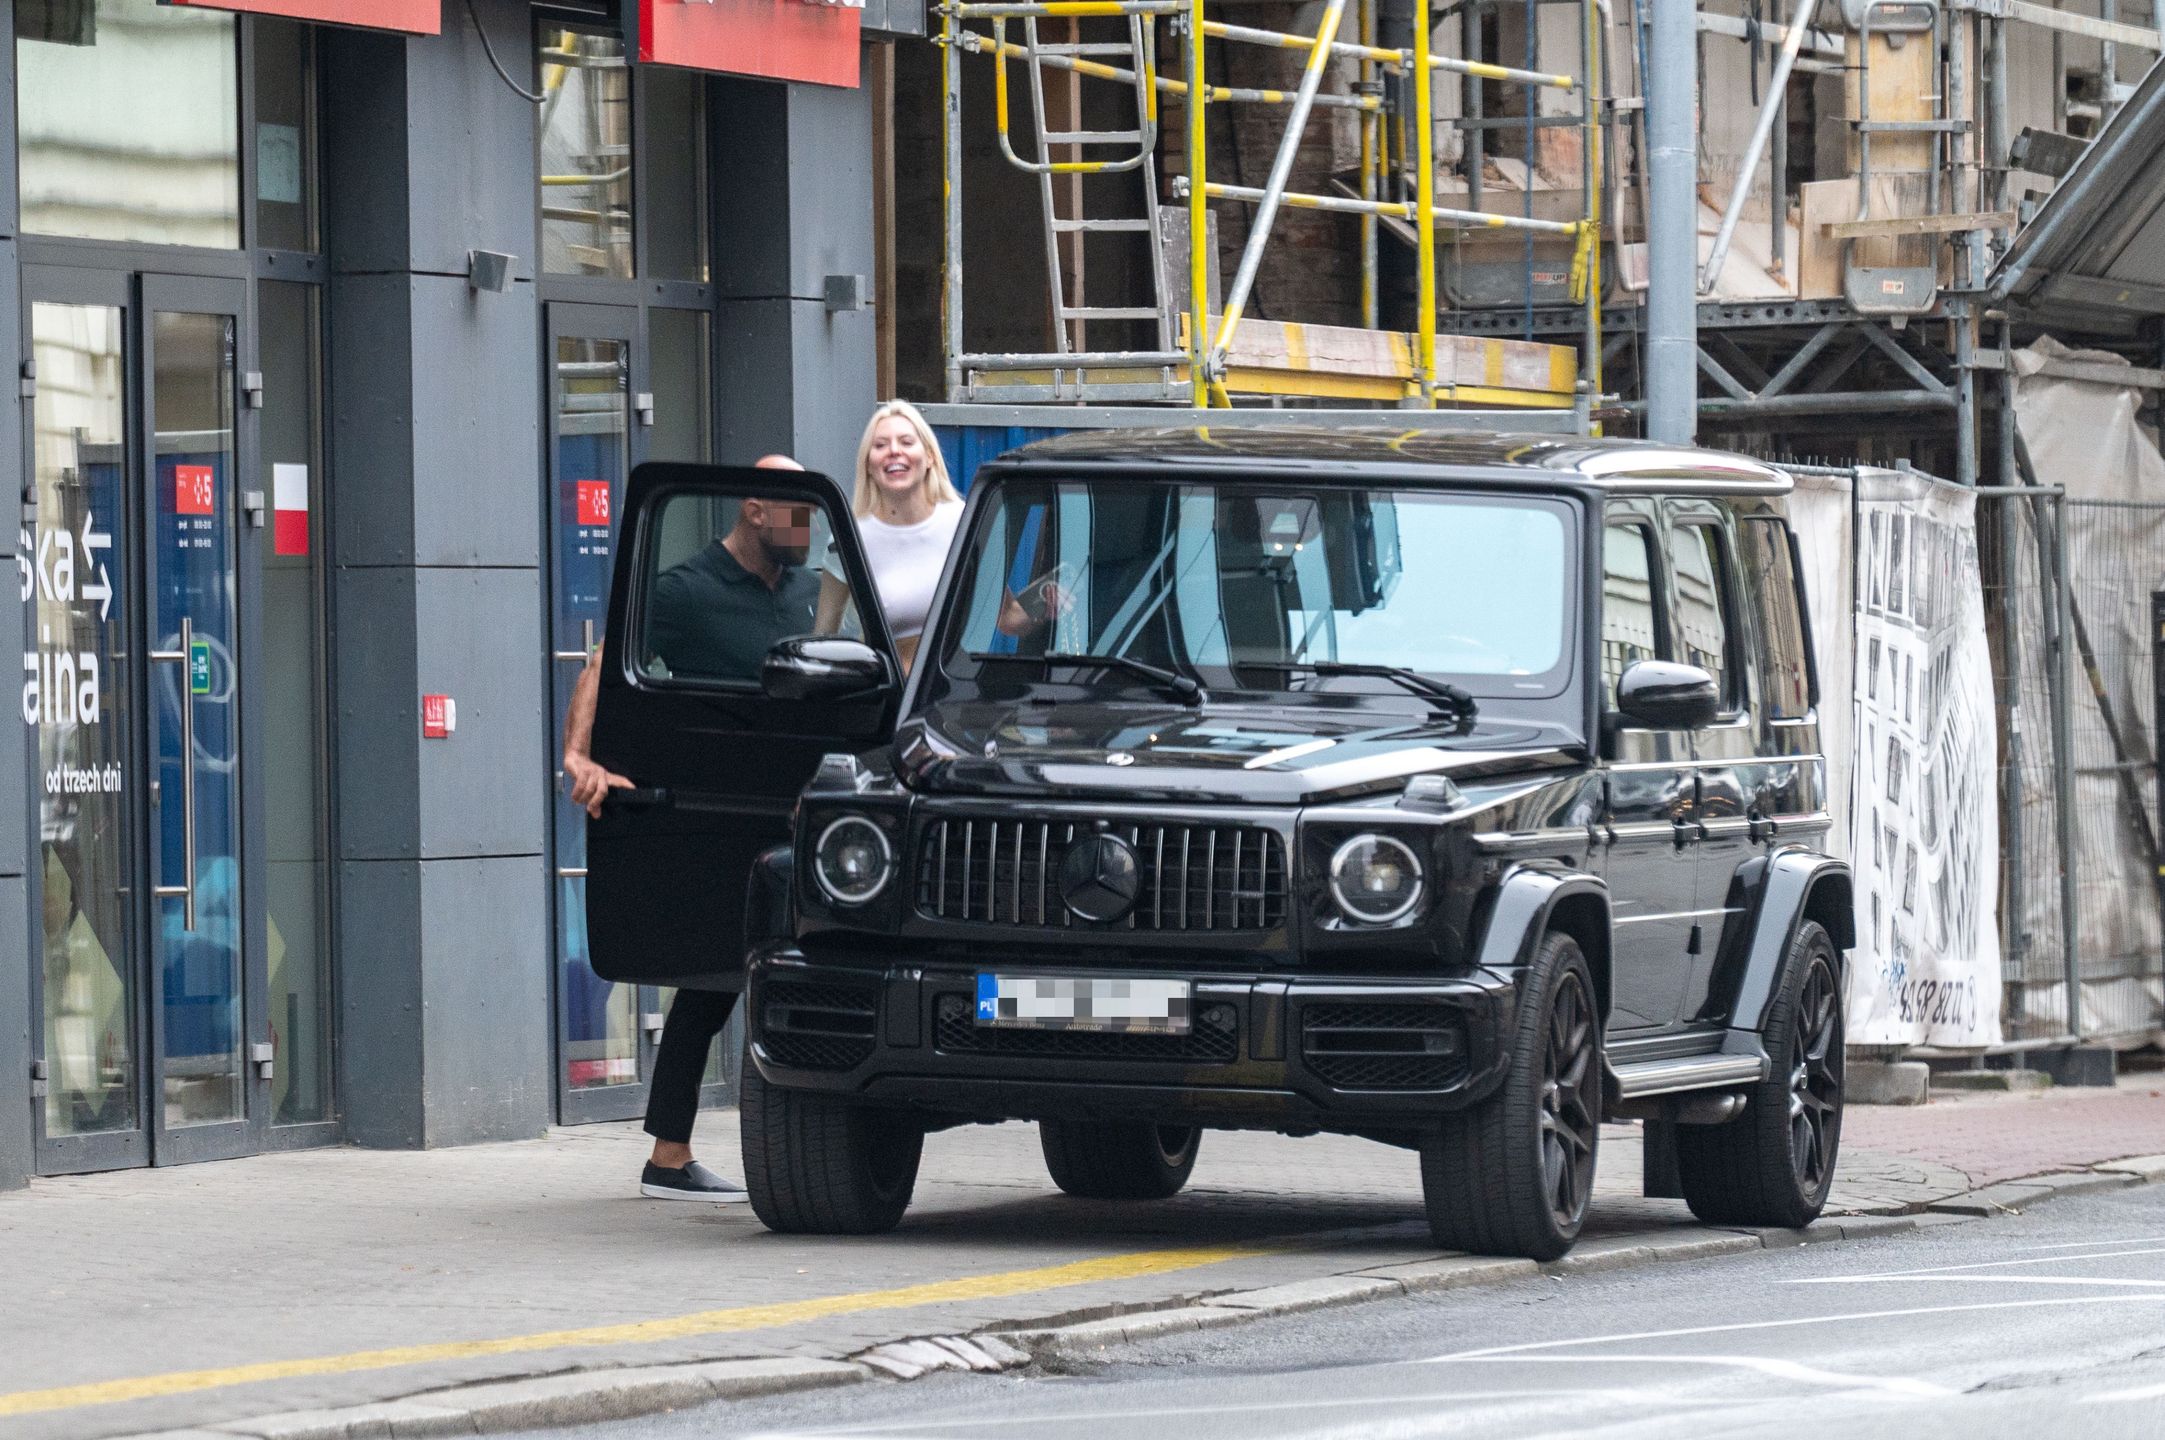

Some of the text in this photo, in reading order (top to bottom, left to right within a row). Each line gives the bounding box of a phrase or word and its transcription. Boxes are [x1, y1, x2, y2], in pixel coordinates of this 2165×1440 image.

[22, 624, 100, 725] aina
[46, 760, 122, 793] od trzech dni
[980, 1001, 993, 1012] PL
